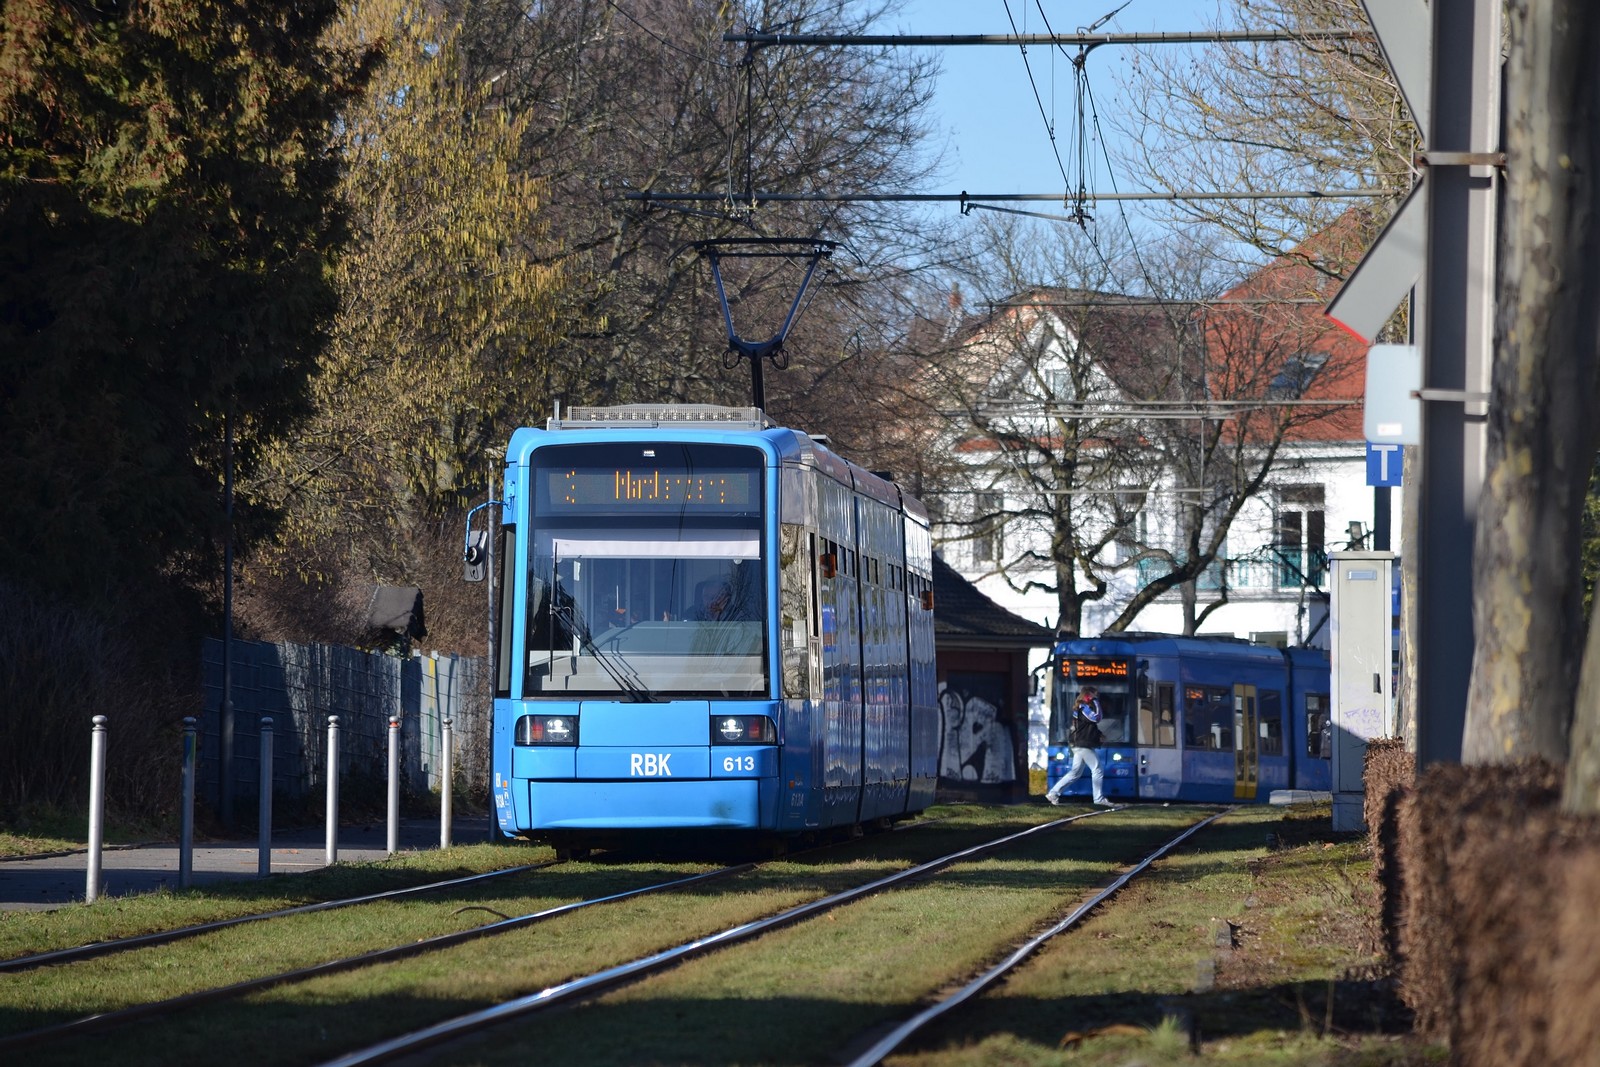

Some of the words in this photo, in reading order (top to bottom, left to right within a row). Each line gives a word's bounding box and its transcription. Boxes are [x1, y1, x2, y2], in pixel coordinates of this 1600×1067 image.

[1371, 444, 1398, 481] T
[630, 753, 672, 777] RBK
[723, 756, 755, 771] 613
